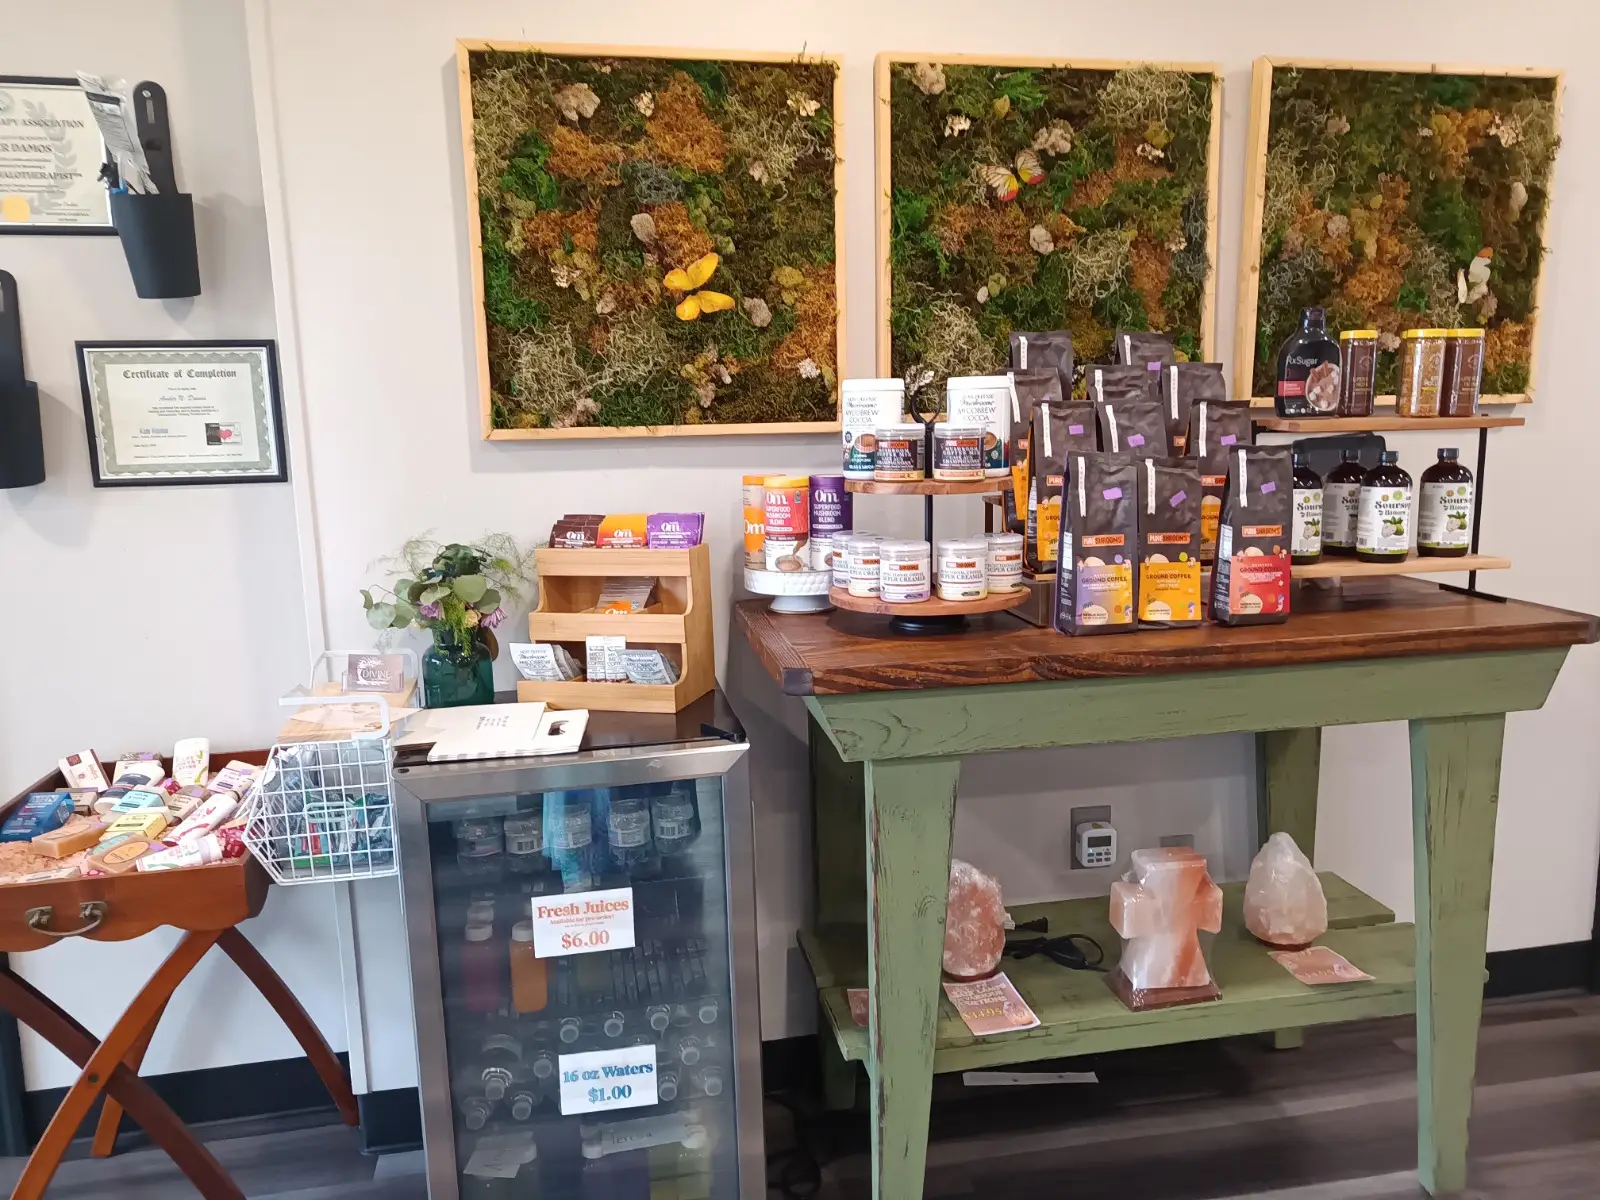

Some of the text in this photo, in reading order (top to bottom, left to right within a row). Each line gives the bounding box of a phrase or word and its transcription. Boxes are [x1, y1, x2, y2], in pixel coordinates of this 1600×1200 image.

[22, 118, 85, 128] ASSOCIATION
[123, 368, 237, 379] Certificate of Completion
[766, 491, 788, 505] Om
[814, 489, 839, 503] Om
[1297, 502, 1322, 511] Sours
[362, 668, 391, 681] DIVINE
[537, 900, 629, 919] Fresh Juices
[561, 930, 610, 950] $6.00
[563, 1063, 654, 1083] 16 oz Waters
[588, 1084, 632, 1104] $1.00
